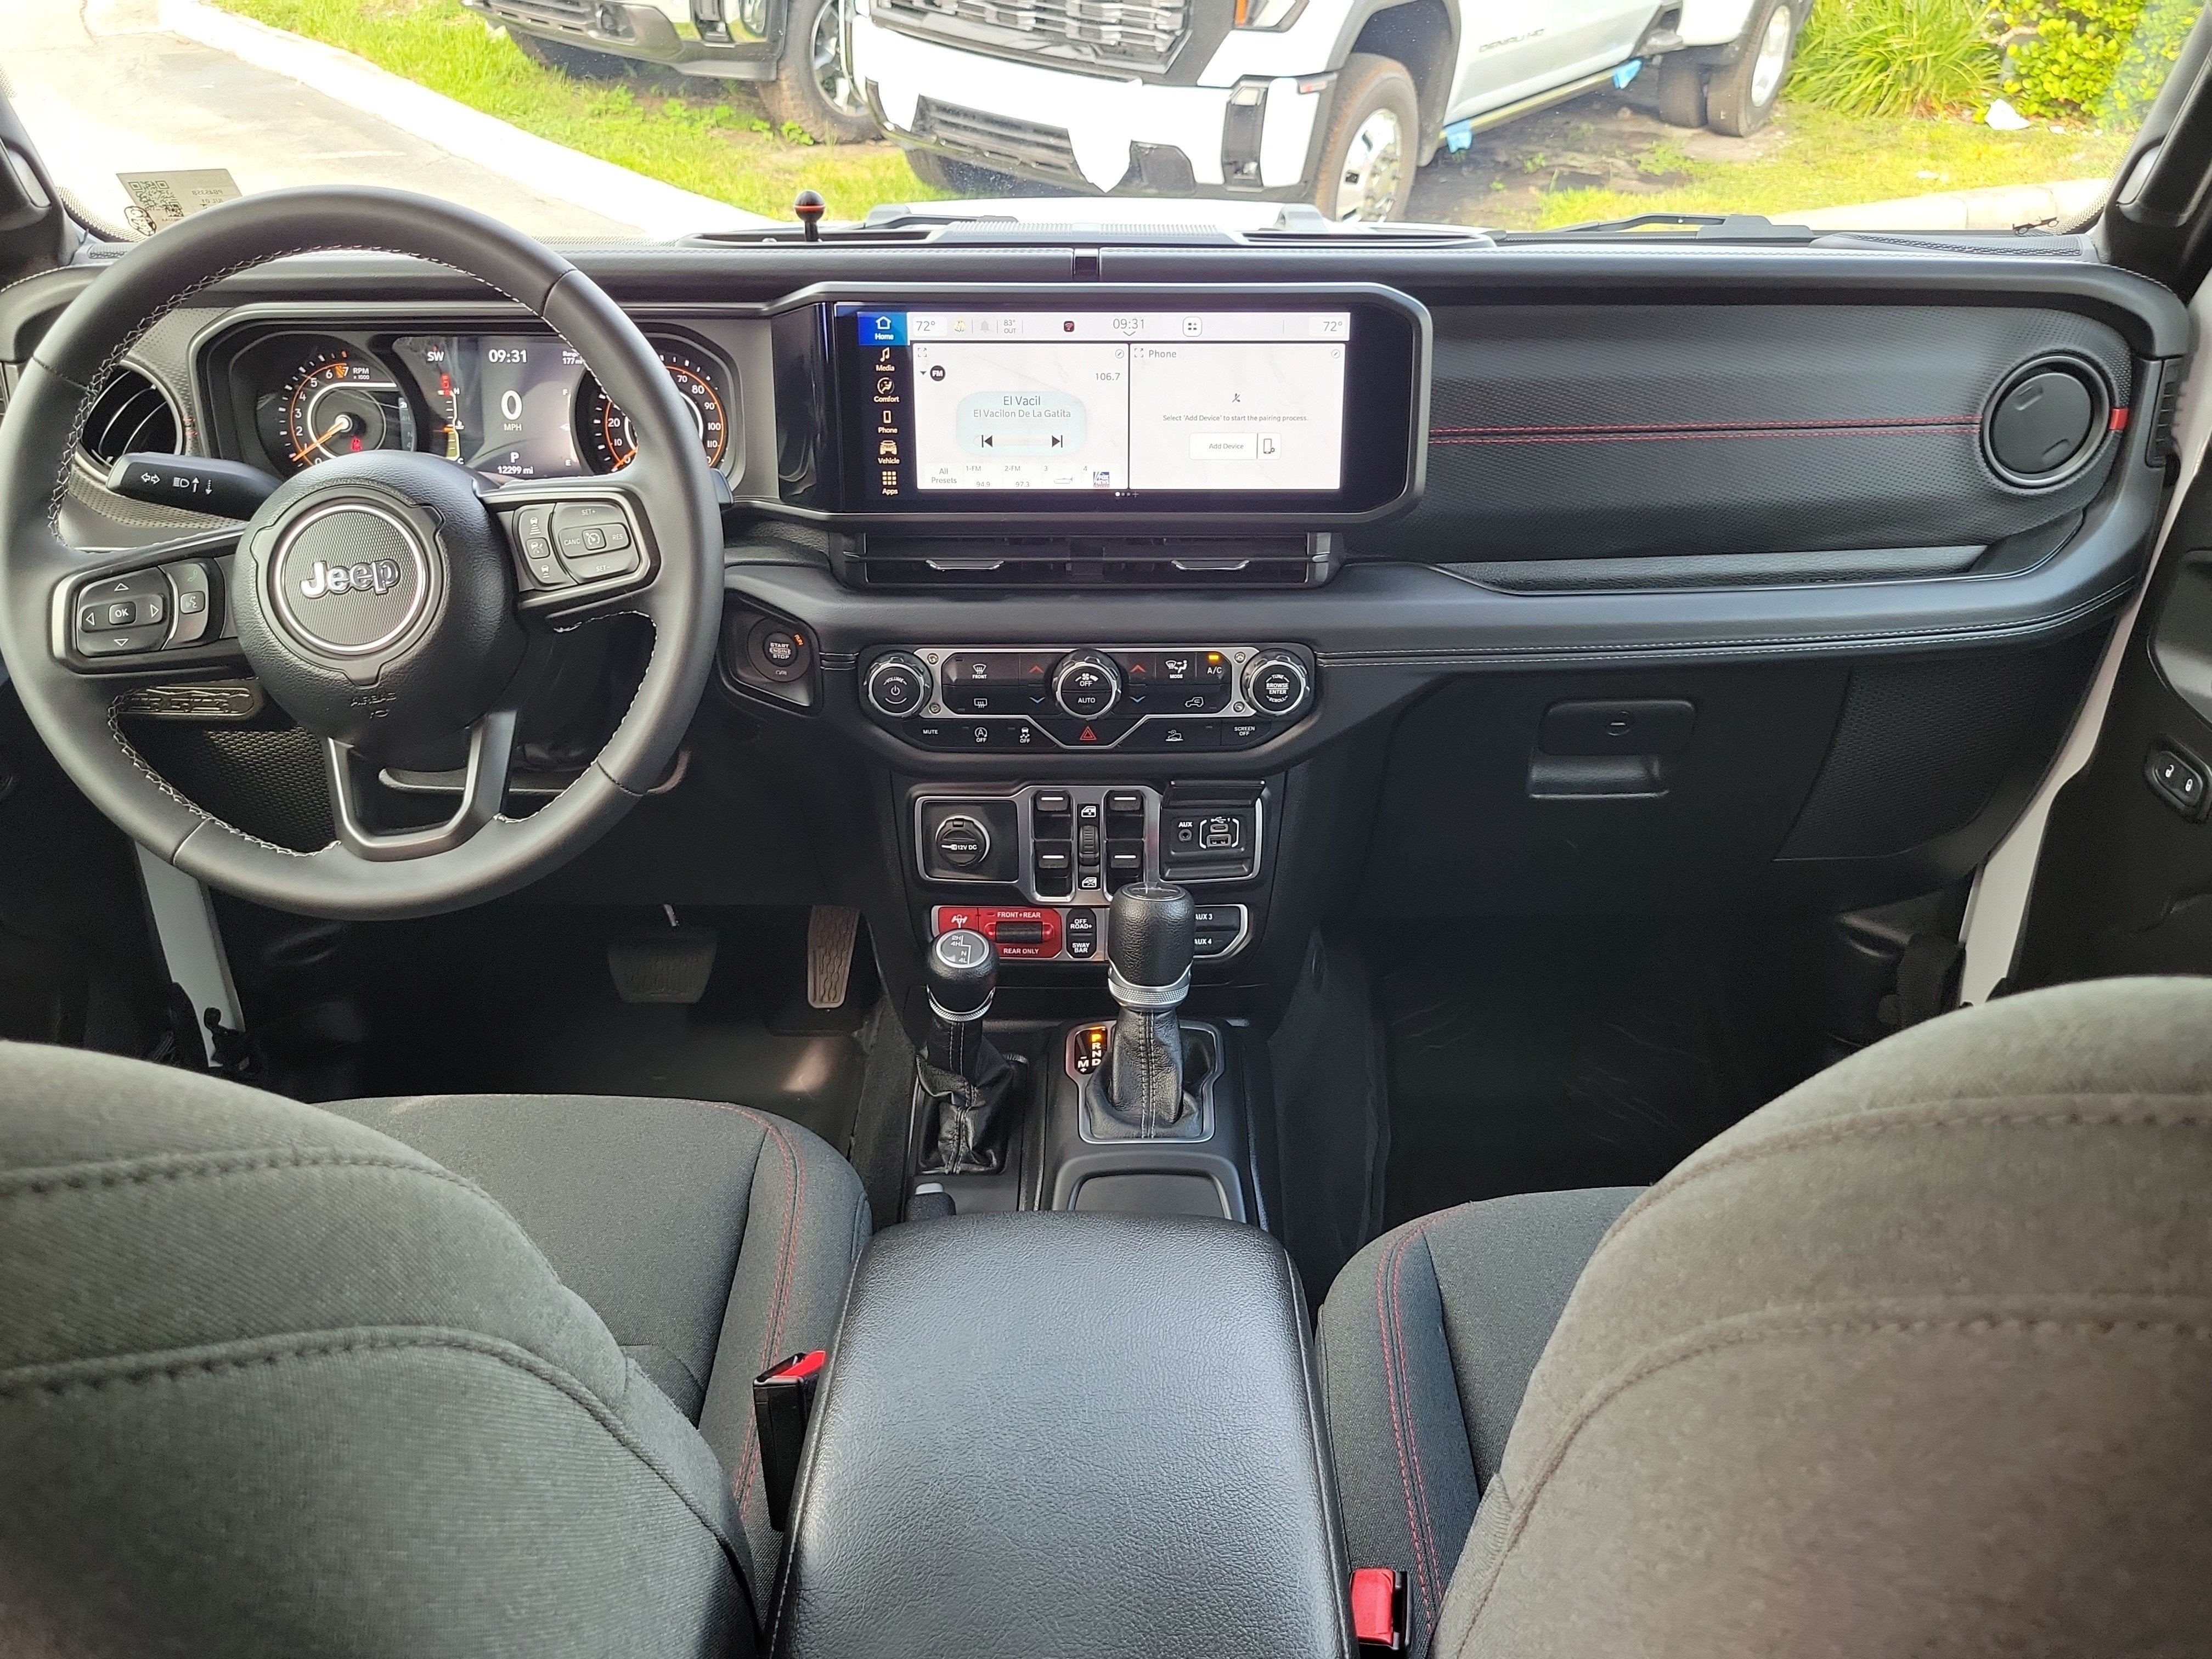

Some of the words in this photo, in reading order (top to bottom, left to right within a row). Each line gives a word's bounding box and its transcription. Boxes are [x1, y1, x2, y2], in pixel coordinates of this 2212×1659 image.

[1113, 318, 1144, 330] 09:31
[427, 352, 444, 362] SW
[488, 349, 528, 363] 09:31
[1148, 349, 1177, 358] Phone
[326, 369, 333, 379] 6
[342, 366, 349, 377] 7
[1096, 373, 1121, 381] 106.7
[311, 377, 318, 388] 5
[691, 385, 706, 394] 80
[299, 391, 307, 401] 4
[1003, 396, 1013, 406] El
[1015, 396, 1041, 406] Vacil
[500, 390, 523, 421] 0
[295, 408, 302, 417] 3
[973, 409, 982, 417] El
[984, 409, 1016, 417] Vacilon
[1018, 409, 1030, 418] De
[1032, 409, 1042, 418] La
[1044, 409, 1071, 418] Gatita
[608, 417, 621, 427] 20
[708, 422, 721, 431] 100
[296, 426, 303, 436] 2
[510, 452, 520, 463] P
[497, 466, 522, 475] 12299
[523, 466, 534, 475] mi
[564, 538, 580, 546] CANC
[300, 558, 401, 600] Jeep
[114, 607, 131, 618] OK
[1206, 666, 1222, 674] A/C
[1091, 1034, 1102, 1042] P
[1077, 1060, 1089, 1068] M
[1092, 1058, 1102, 1066] D
